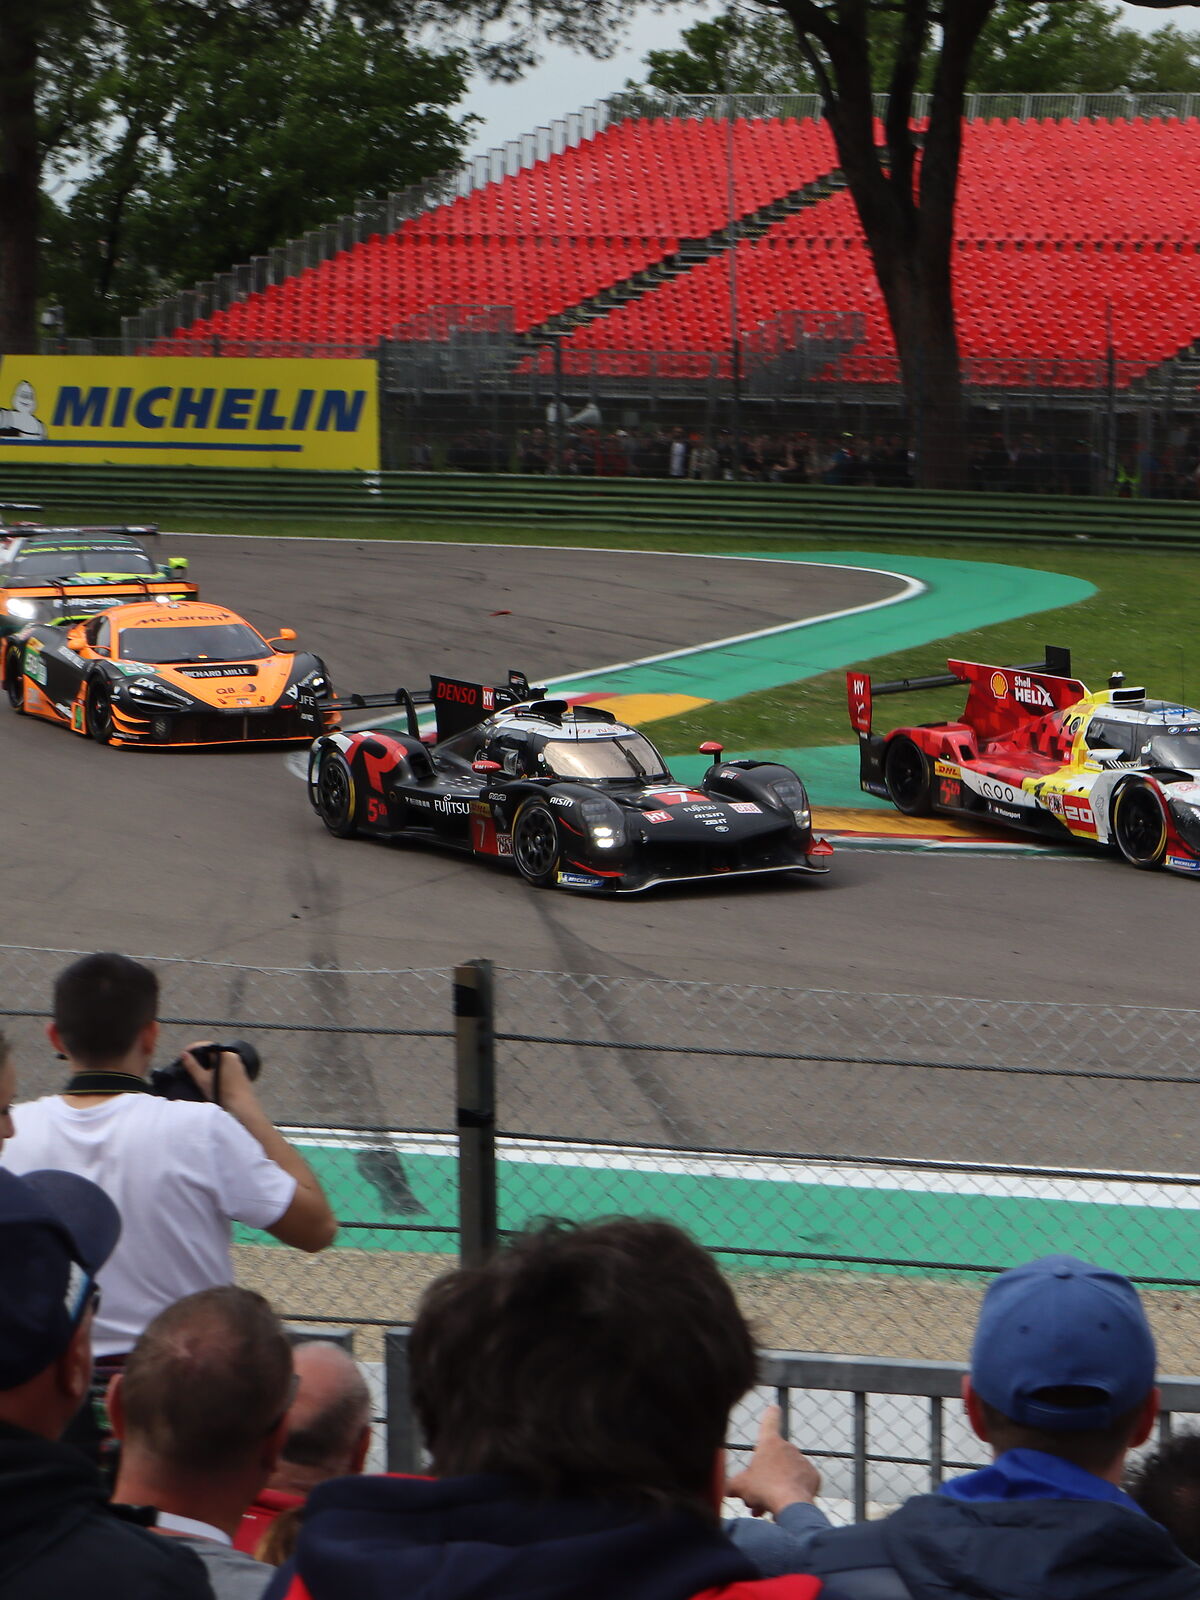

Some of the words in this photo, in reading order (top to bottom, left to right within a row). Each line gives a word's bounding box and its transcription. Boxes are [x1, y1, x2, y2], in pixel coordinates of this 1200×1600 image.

[52, 386, 367, 432] MICHELIN
[223, 667, 250, 676] MILLE
[854, 680, 864, 695] HY
[1014, 675, 1031, 688] Shell
[436, 682, 477, 705] DENSO
[483, 691, 494, 706] HY
[1015, 685, 1054, 707] HELIX
[938, 766, 958, 776] DHL
[668, 792, 688, 802] 7
[978, 780, 1014, 802] iQOO
[367, 798, 388, 822] 5th
[434, 793, 470, 815] FUJITSU
[550, 797, 573, 807] AISIN
[645, 811, 668, 821] HY
[1065, 806, 1094, 823] 20
[476, 820, 485, 848] 7
